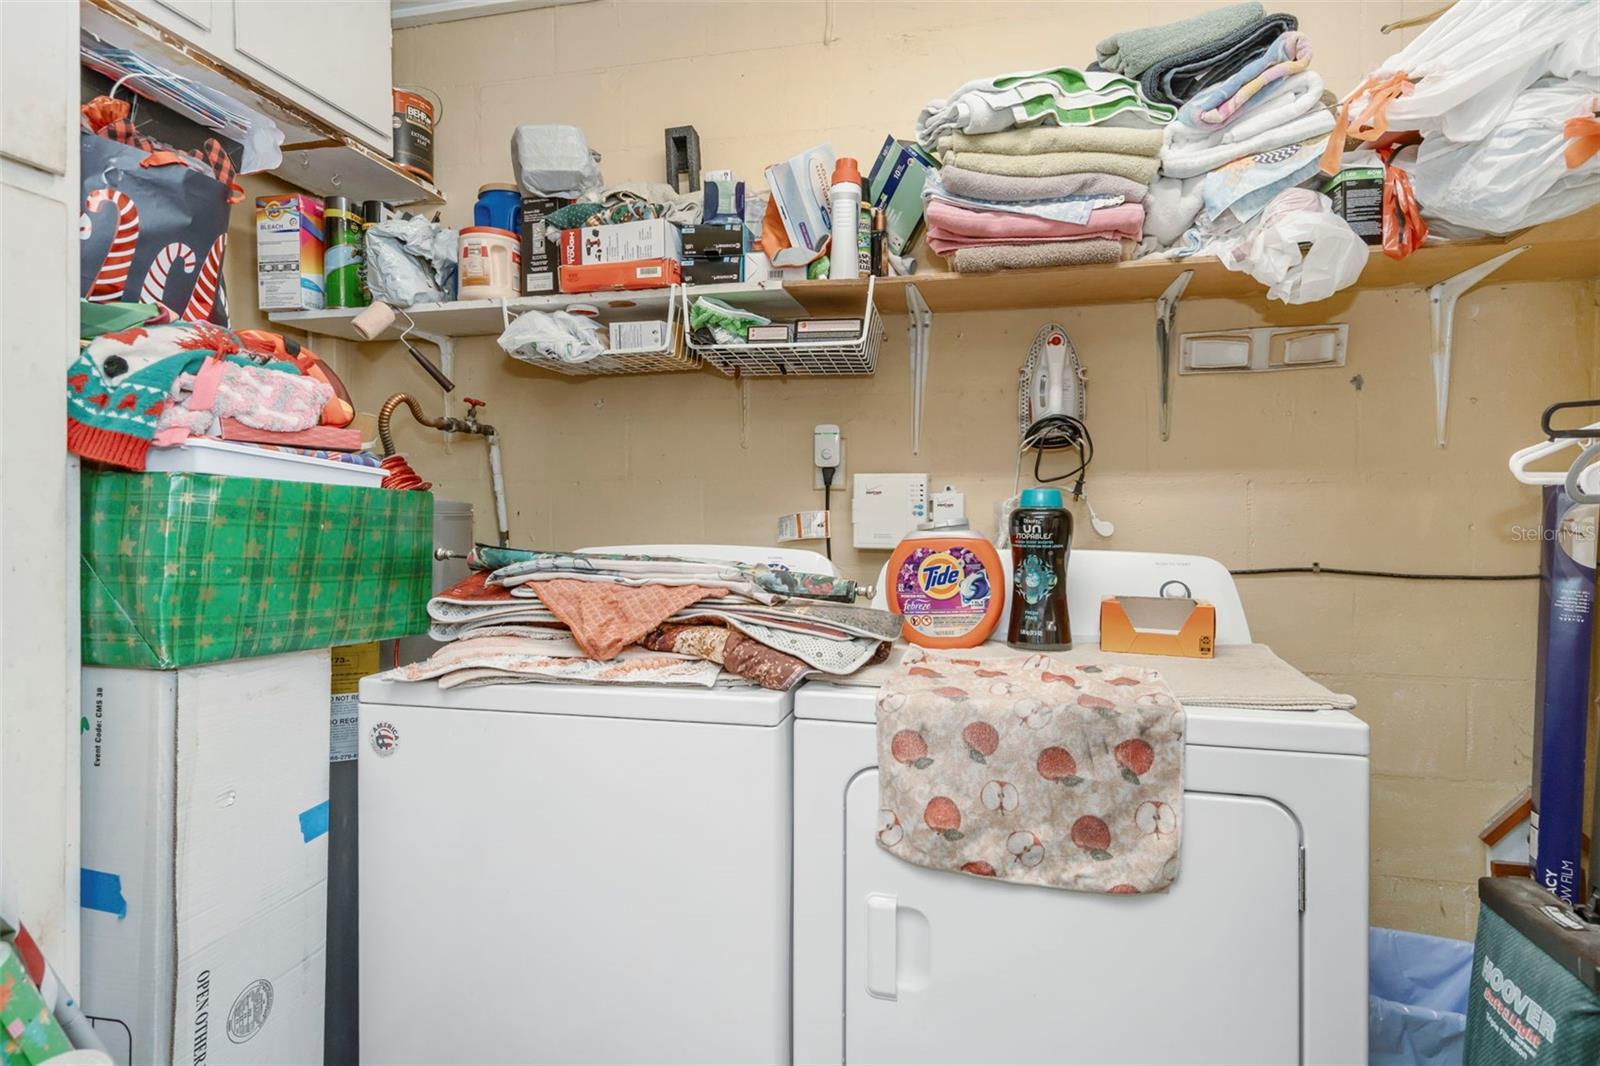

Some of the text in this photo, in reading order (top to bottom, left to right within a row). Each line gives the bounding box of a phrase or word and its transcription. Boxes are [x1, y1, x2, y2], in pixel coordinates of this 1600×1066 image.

[922, 565, 960, 591] Tide
[903, 599, 931, 612] febreze
[95, 700, 103, 718] CMS
[94, 720, 102, 744] Code:
[93, 745, 101, 767] Event
[1482, 955, 1557, 1044] HOOVER
[193, 969, 210, 1066] OPEN OTHER
